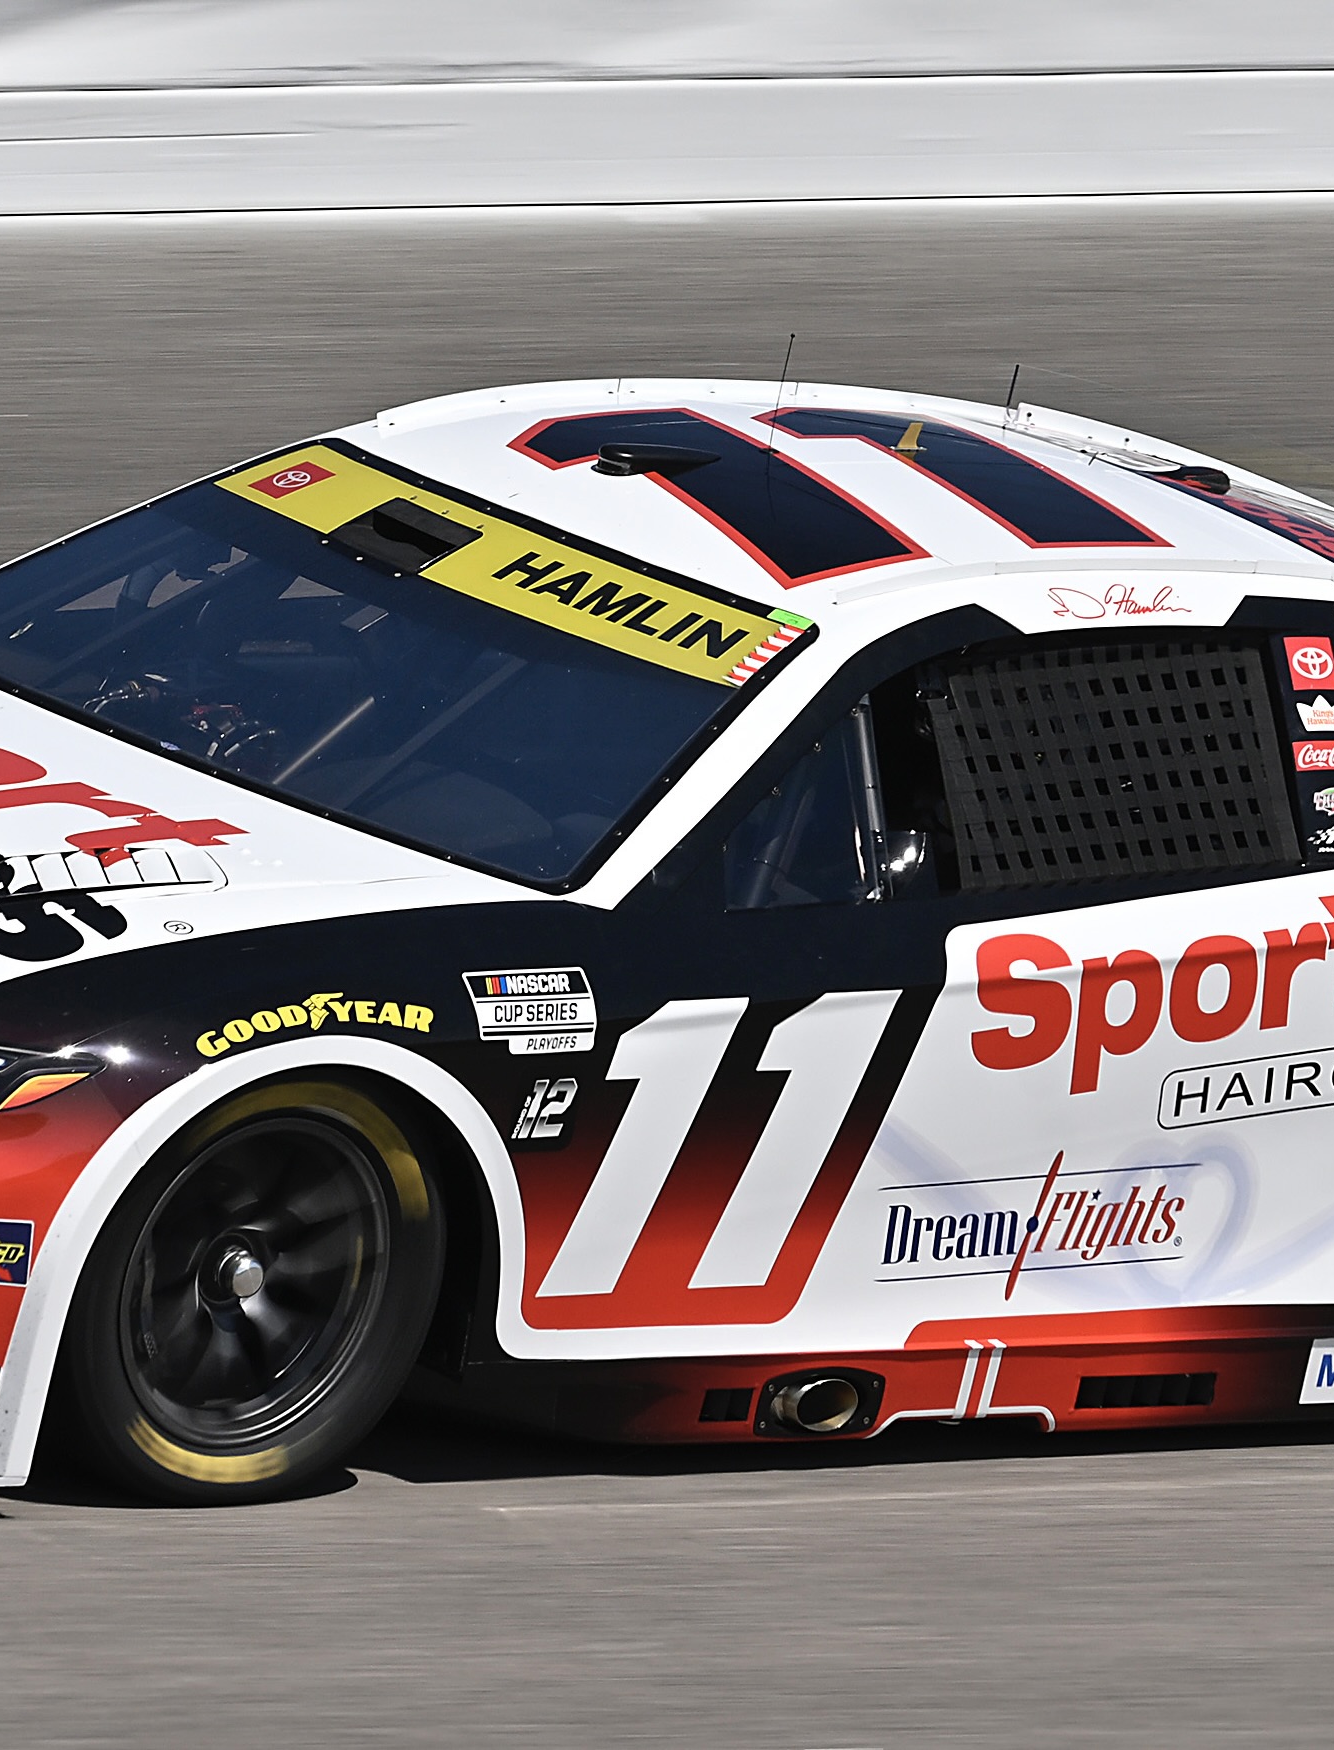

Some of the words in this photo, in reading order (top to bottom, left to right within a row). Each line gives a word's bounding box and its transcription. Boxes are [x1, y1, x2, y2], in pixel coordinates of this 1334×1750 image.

[506, 407, 1174, 588] 11
[491, 552, 749, 659] HAMLIN
[494, 1004, 523, 1023] CUP
[526, 1002, 578, 1022] SERIES
[505, 973, 571, 995] NASCAR
[526, 1036, 578, 1051] PLAYOFFS
[518, 1078, 578, 1139] 12
[535, 990, 902, 1298] 11
[881, 1204, 1018, 1265] Dream
[1031, 1184, 1185, 1261] Flights
